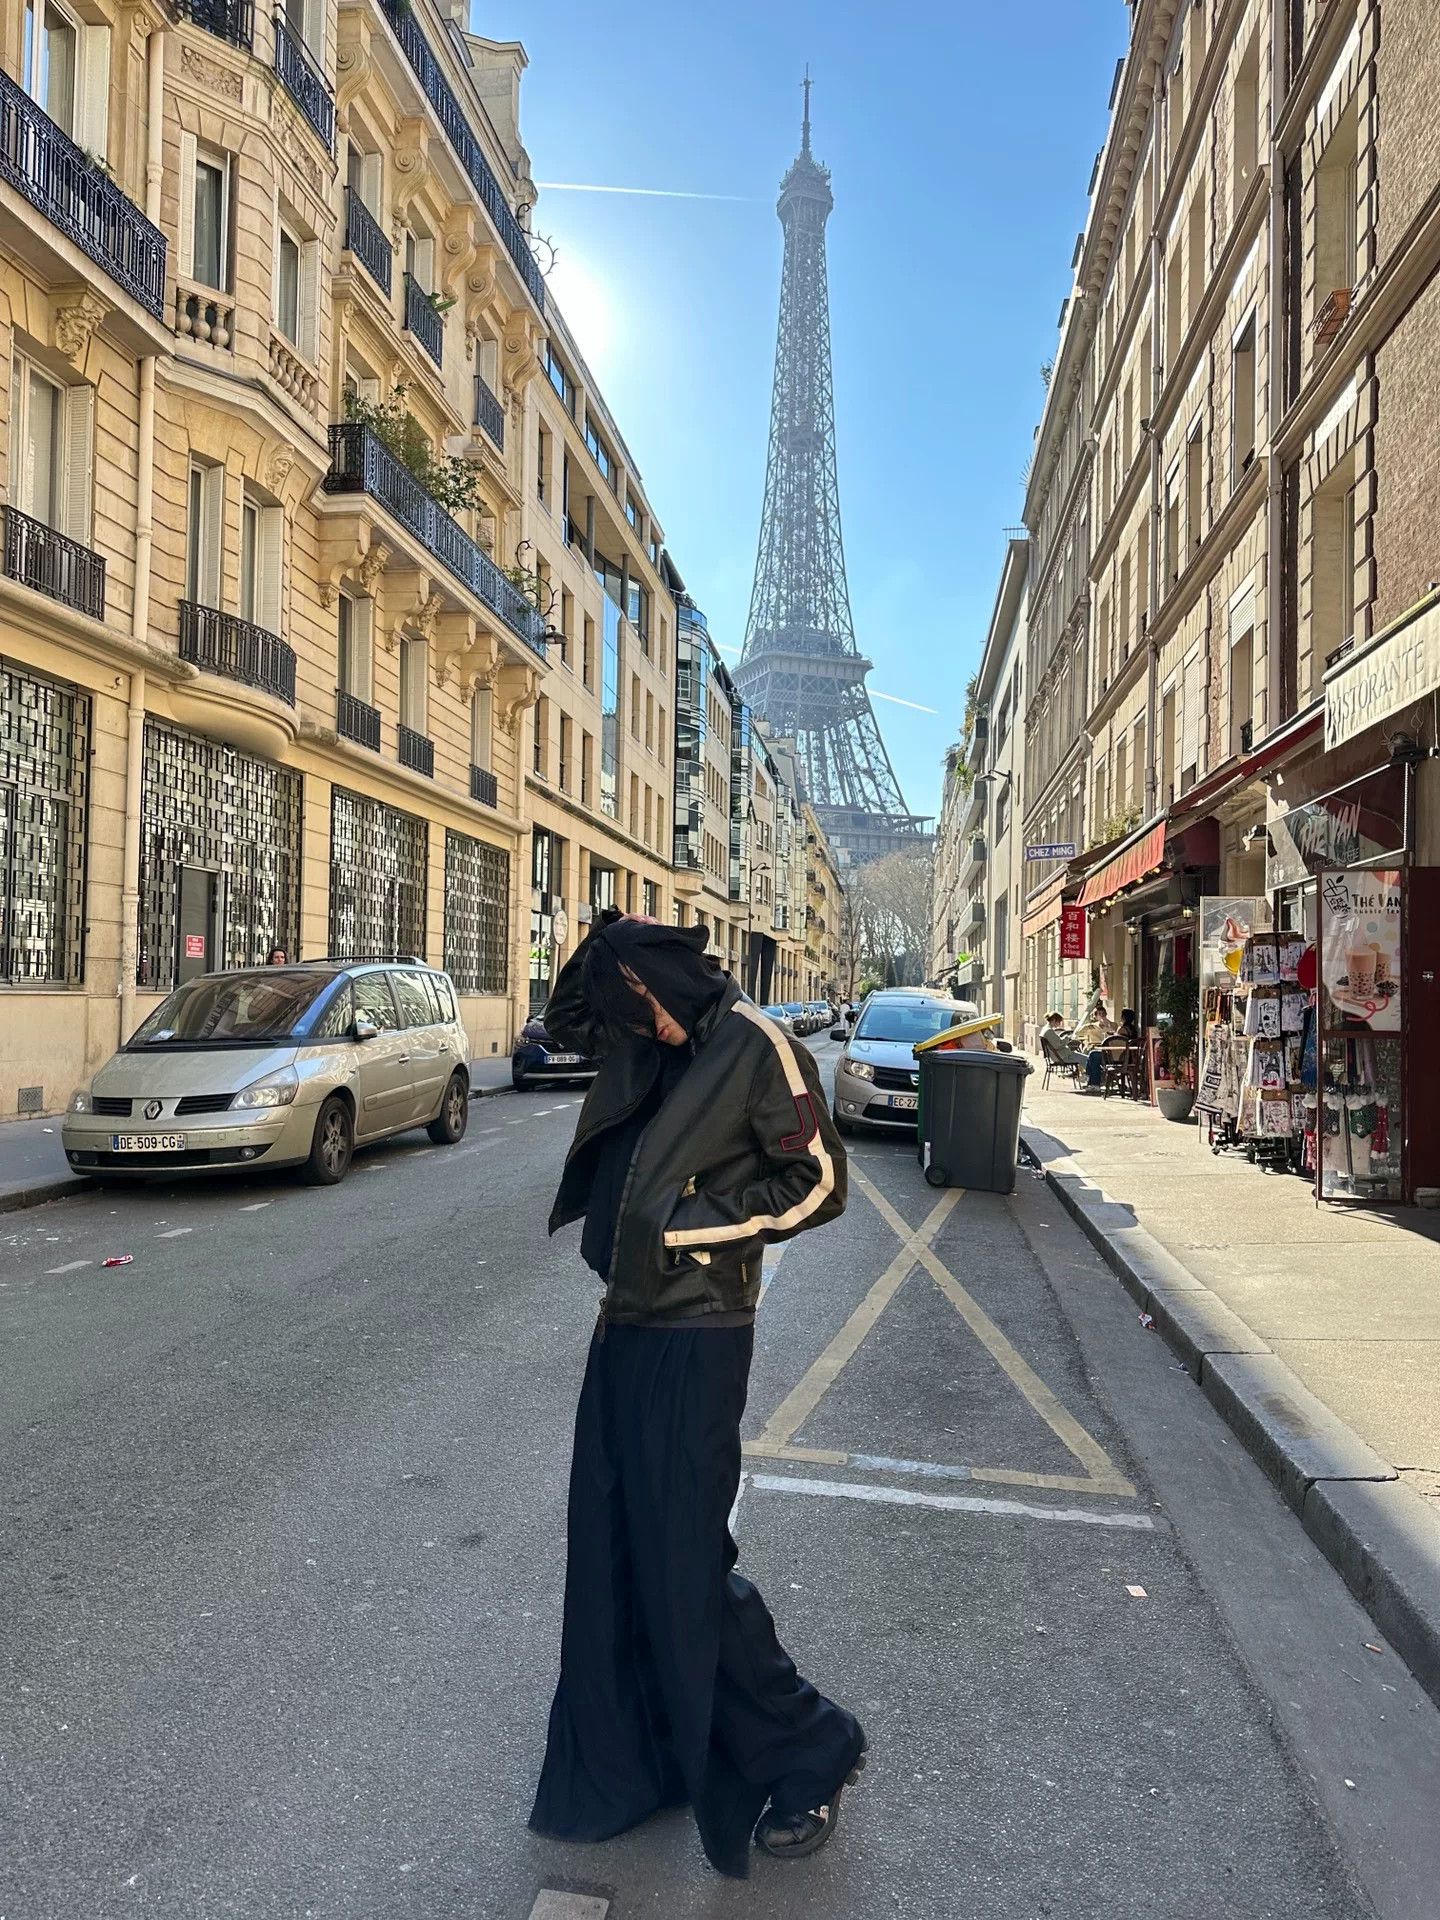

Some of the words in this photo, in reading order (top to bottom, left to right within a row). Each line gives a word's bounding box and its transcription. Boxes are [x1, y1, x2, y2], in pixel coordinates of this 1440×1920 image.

[1328, 639, 1425, 728] RISTORANTE
[1028, 847, 1050, 858] CHEZ
[1052, 846, 1074, 856] MING
[893, 1097, 918, 1108] EC-27
[120, 1136, 176, 1149] DE-509-CG
